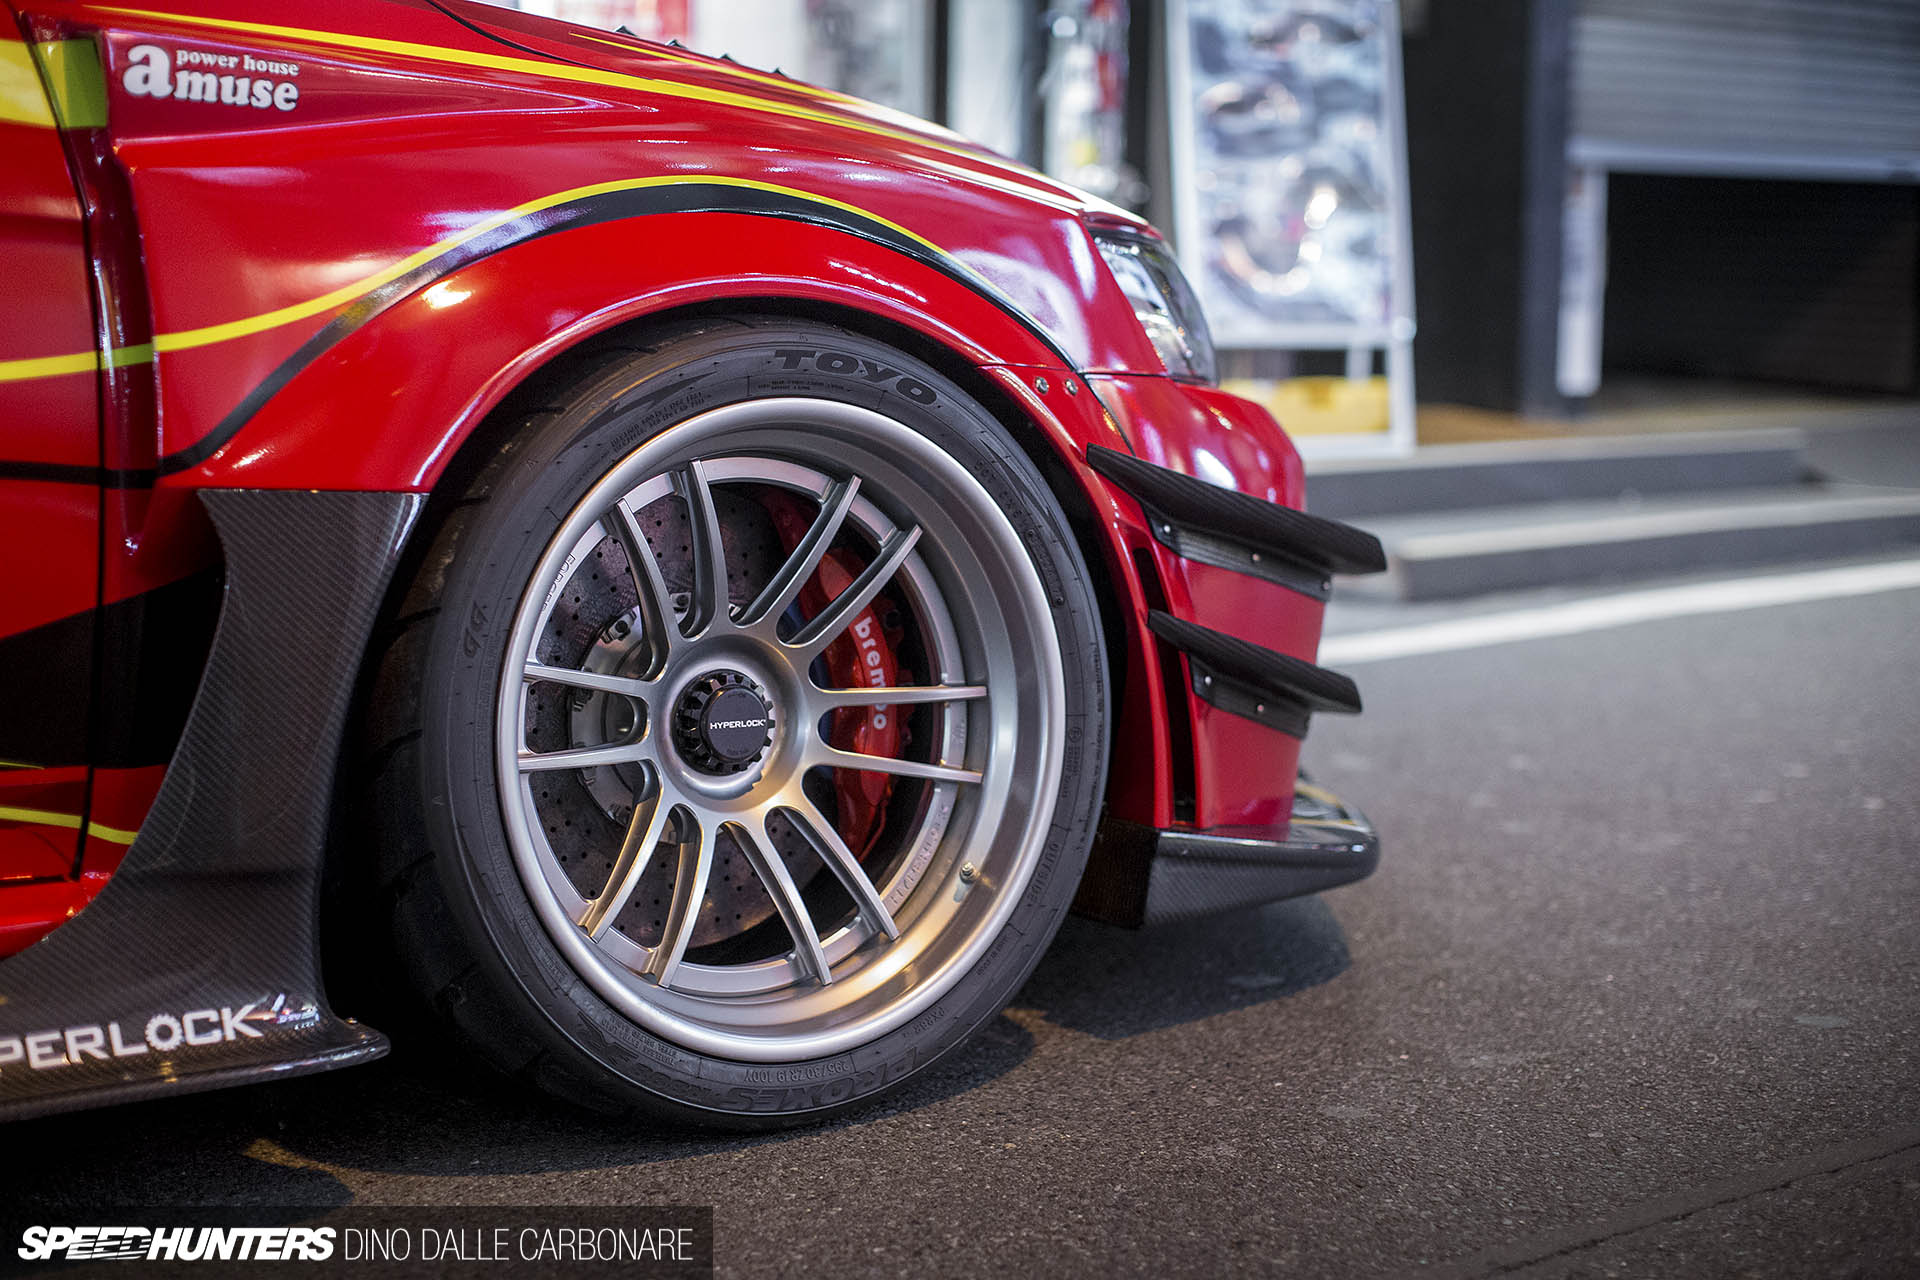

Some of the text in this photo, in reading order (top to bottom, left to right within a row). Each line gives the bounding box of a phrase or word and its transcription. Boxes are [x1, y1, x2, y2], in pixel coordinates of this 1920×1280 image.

[176, 49, 299, 76] power house
[773, 350, 938, 406] TOYO
[710, 719, 766, 730] HYPERLOCK
[722, 1047, 918, 1112] PROXES
